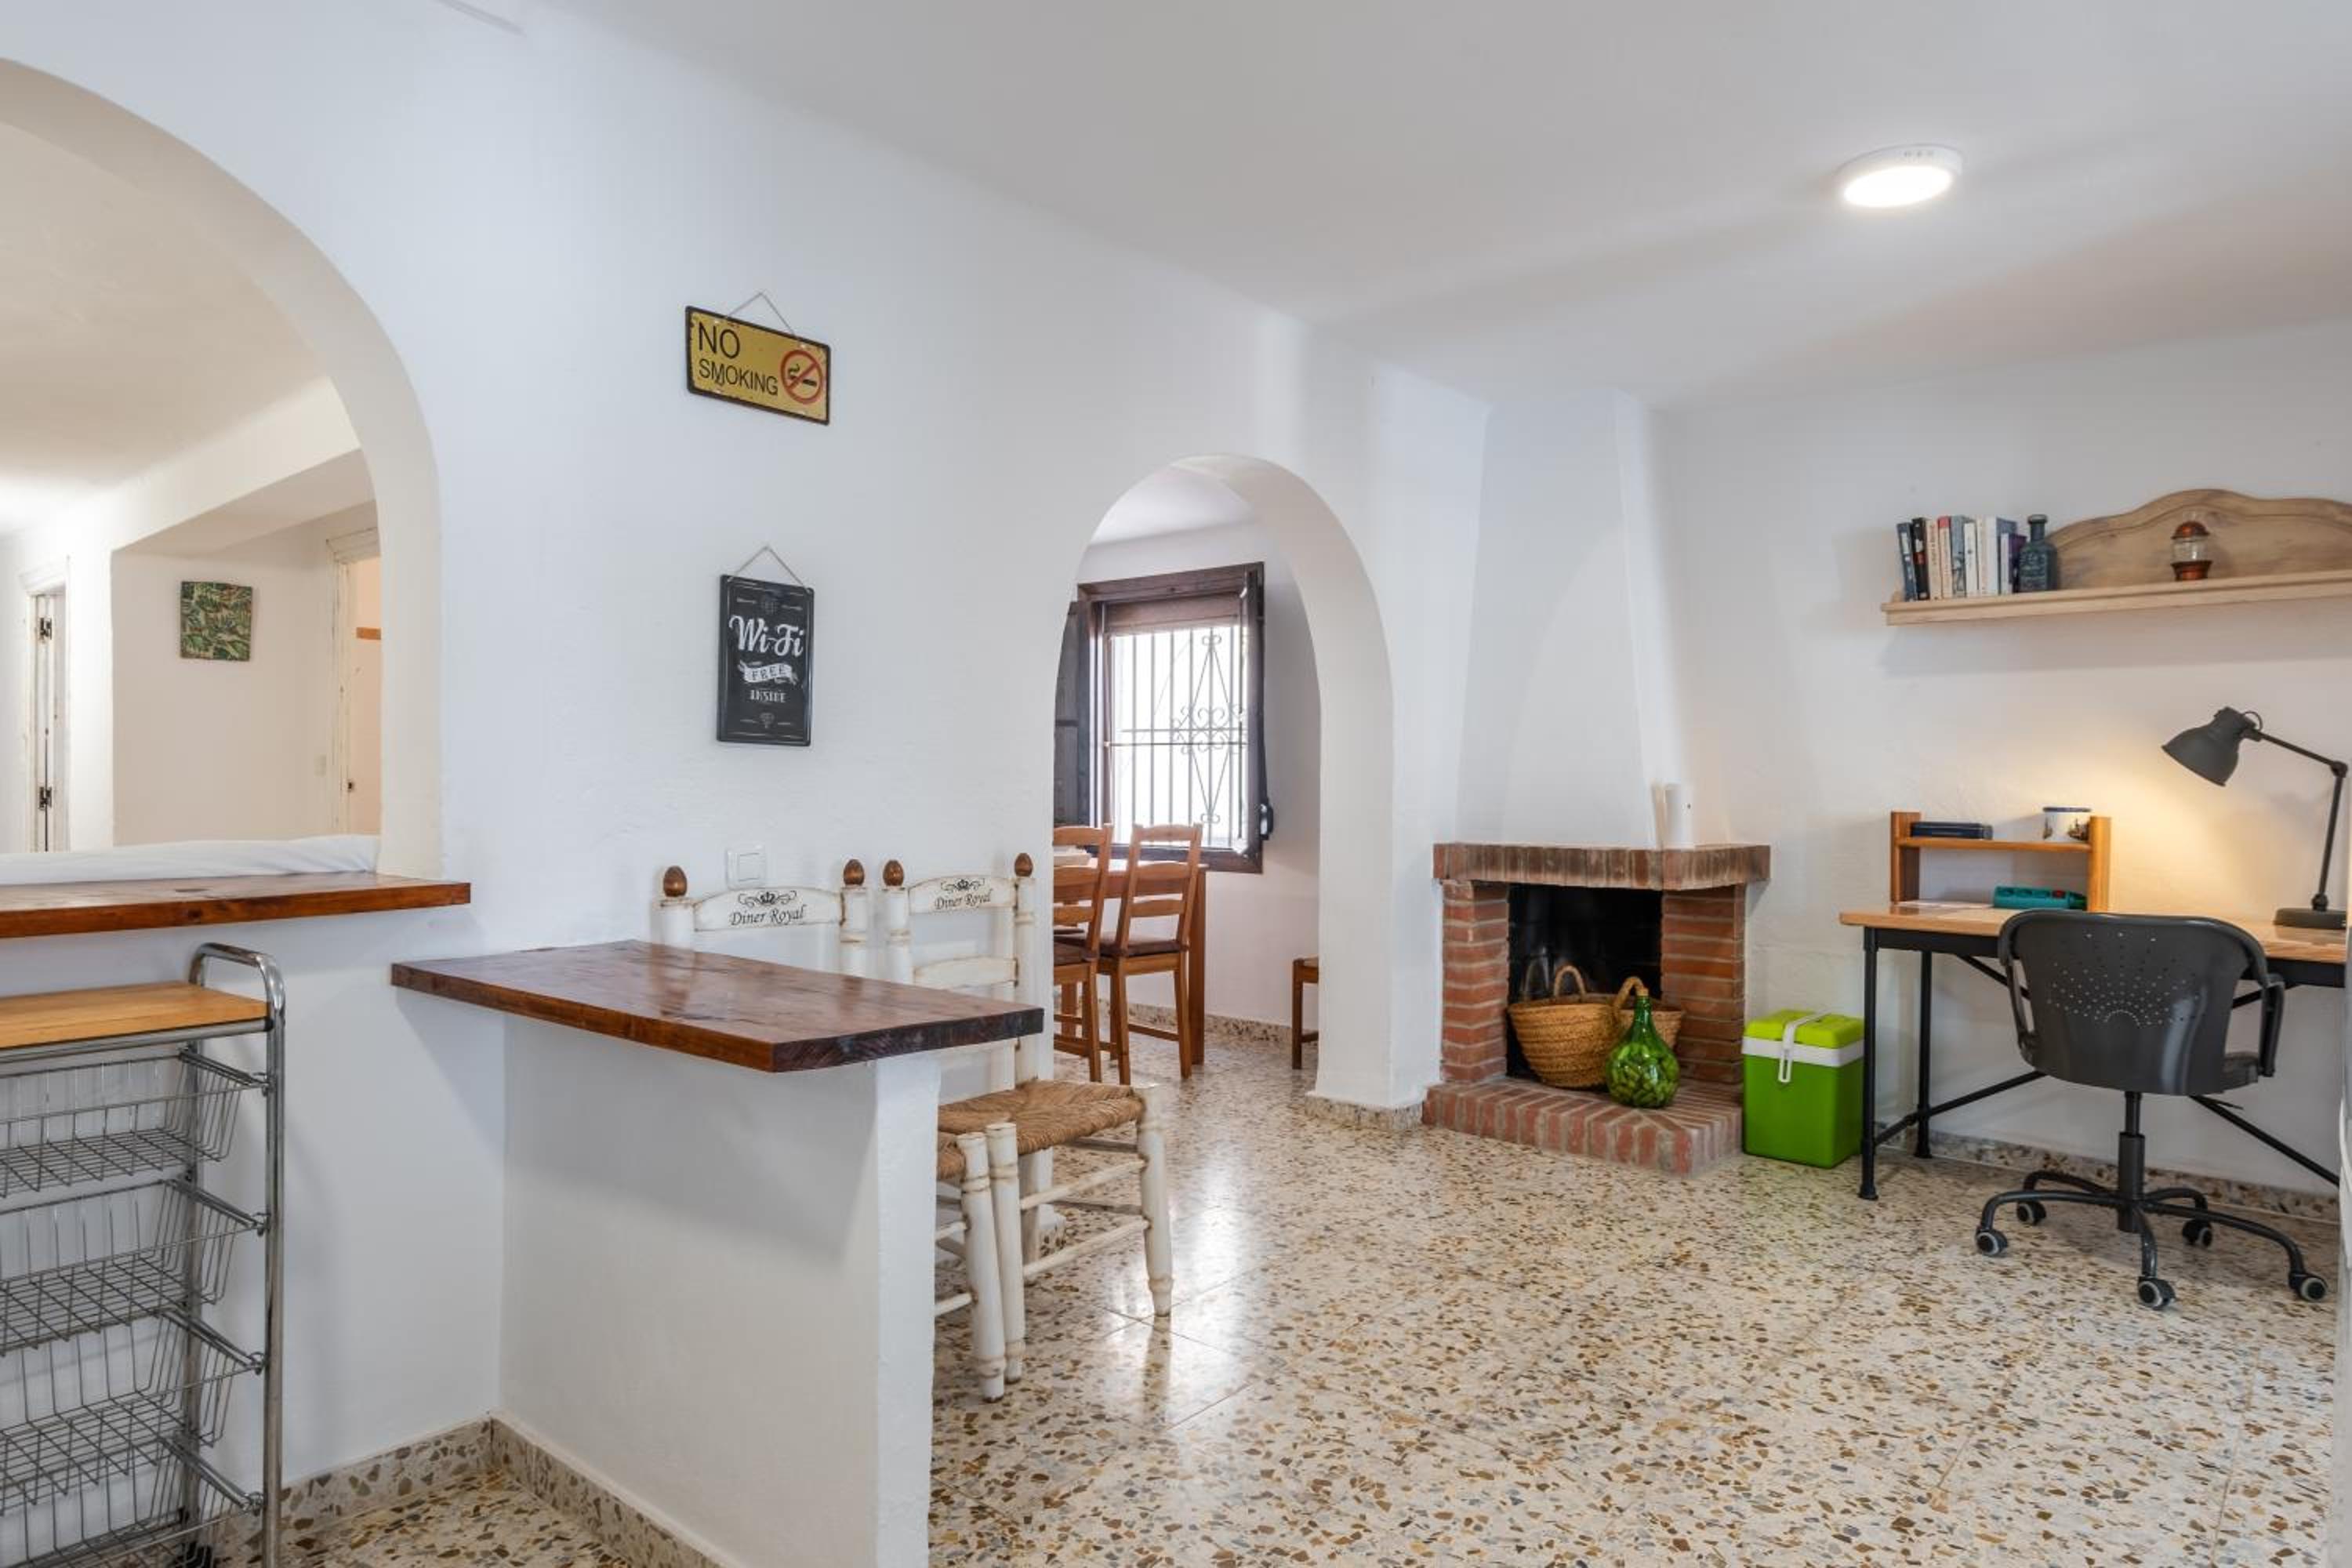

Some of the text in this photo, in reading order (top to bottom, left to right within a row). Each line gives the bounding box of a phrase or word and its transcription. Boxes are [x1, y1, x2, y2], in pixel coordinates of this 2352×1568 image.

[698, 321, 739, 359] NO
[699, 358, 779, 396] SMOKING
[752, 664, 786, 681] FREE
[935, 889, 993, 910] Diner Royal
[729, 904, 807, 926] Diner Royal
